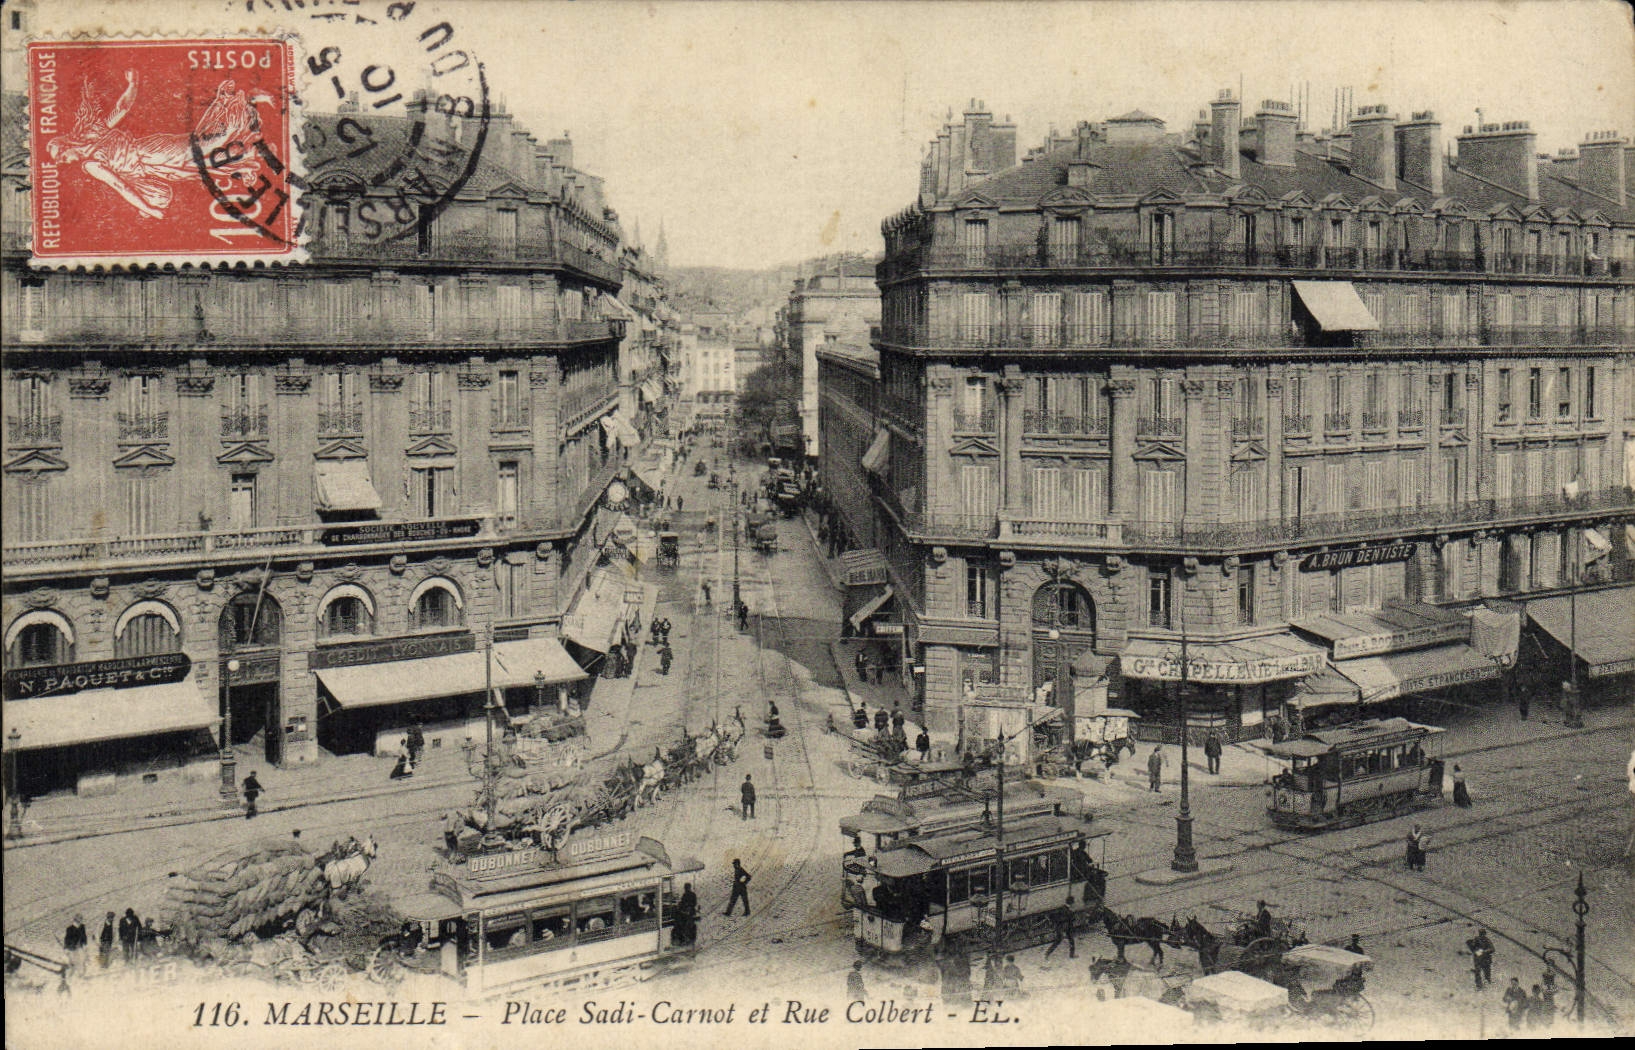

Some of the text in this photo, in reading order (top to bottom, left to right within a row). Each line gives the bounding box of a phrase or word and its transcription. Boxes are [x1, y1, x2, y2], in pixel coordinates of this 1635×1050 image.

[188, 50, 271, 69] POSTES
[38, 51, 60, 249] REPUBLIQUE FRANÇAISE
[1356, 544, 1413, 562] DENTISTE
[44, 670, 132, 690] PAQUET
[135, 671, 145, 681] &
[571, 833, 632, 856] DUBONNET
[471, 850, 536, 872] DUBONNET
